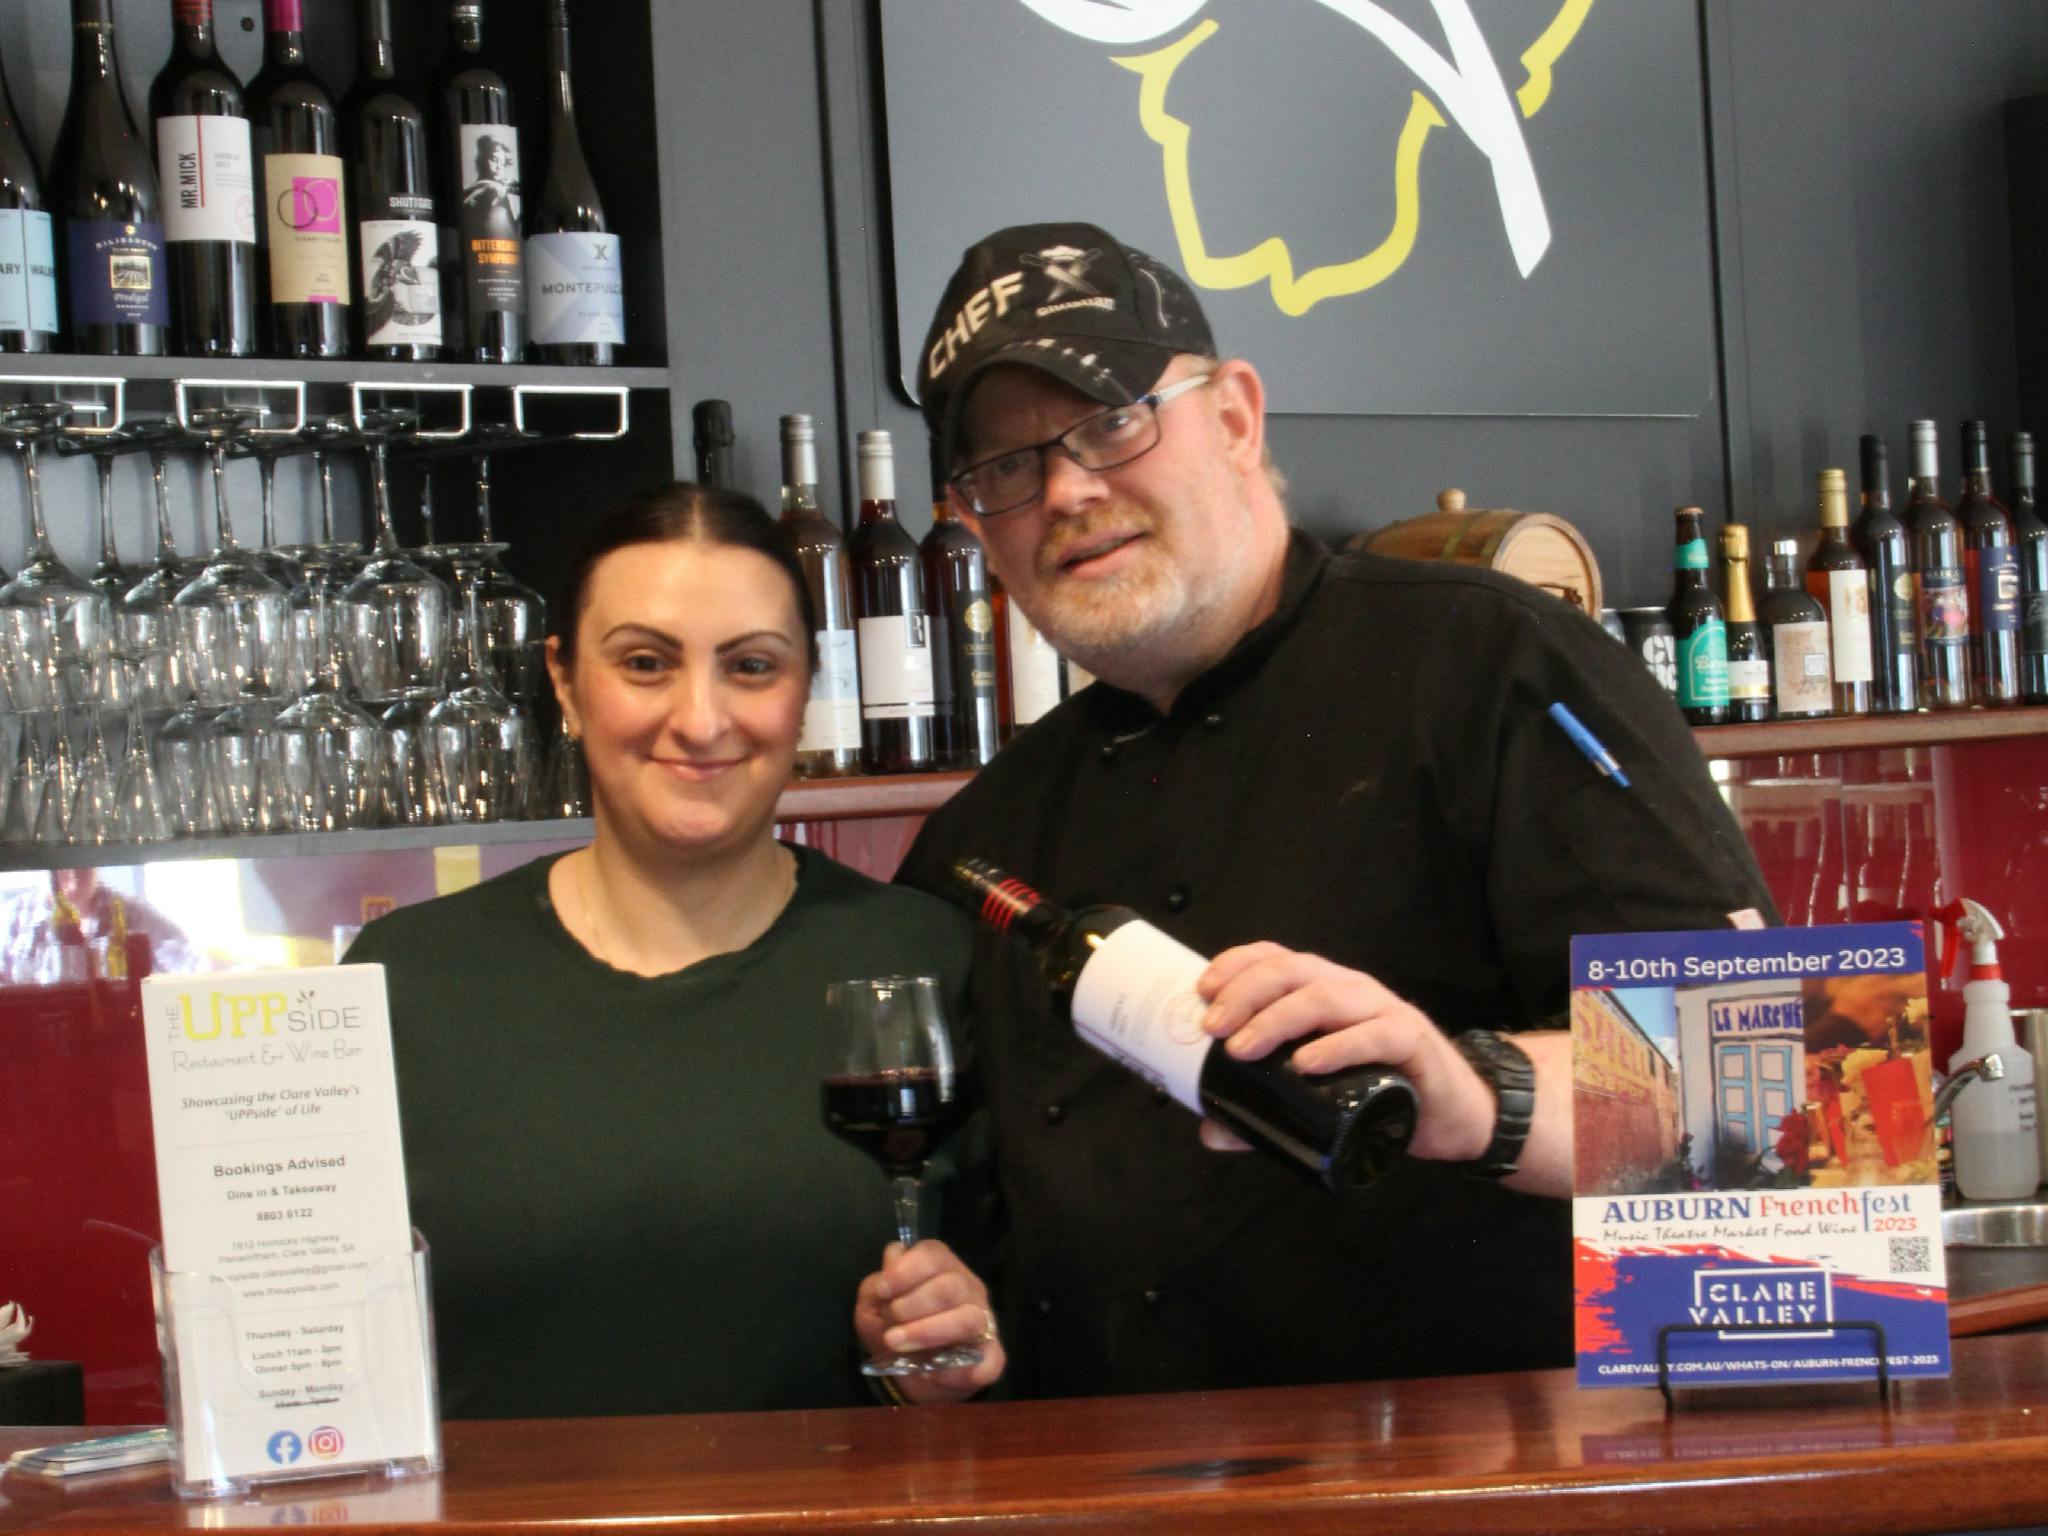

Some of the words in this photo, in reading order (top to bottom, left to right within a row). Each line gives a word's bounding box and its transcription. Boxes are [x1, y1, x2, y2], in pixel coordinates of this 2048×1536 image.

[929, 271, 1025, 380] CHEF
[1587, 957, 1677, 980] 8-10th
[1683, 952, 1832, 979] September
[1838, 948, 1905, 970] 2023
[166, 1005, 181, 1042] THE
[172, 1050, 257, 1074] Restaurant
[286, 1041, 329, 1063] Wine
[333, 1038, 362, 1061] Bar
[181, 1093, 254, 1110] Showcasing
[258, 1091, 277, 1103] the
[280, 1088, 311, 1100] Clare
[285, 1103, 299, 1116] of
[300, 1102, 322, 1114] Life
[213, 1162, 283, 1178] Bookings
[287, 1154, 346, 1171] Advised
[227, 1189, 254, 1201] Dine
[256, 1188, 267, 1199] in
[271, 1186, 279, 1196] &
[283, 1182, 337, 1196] Takeaway
[1602, 1197, 1751, 1223] AUBURN
[1603, 1228, 1649, 1241] Music
[1656, 1226, 1707, 1240] Theatre
[1713, 1225, 1767, 1239] Market
[1774, 1223, 1811, 1236] Food
[1819, 1221, 1857, 1235] Wine
[1873, 1217, 1917, 1232] 2023
[1709, 1281, 1817, 1303] CLARE
[1688, 1304, 1818, 1326] VALLEY
